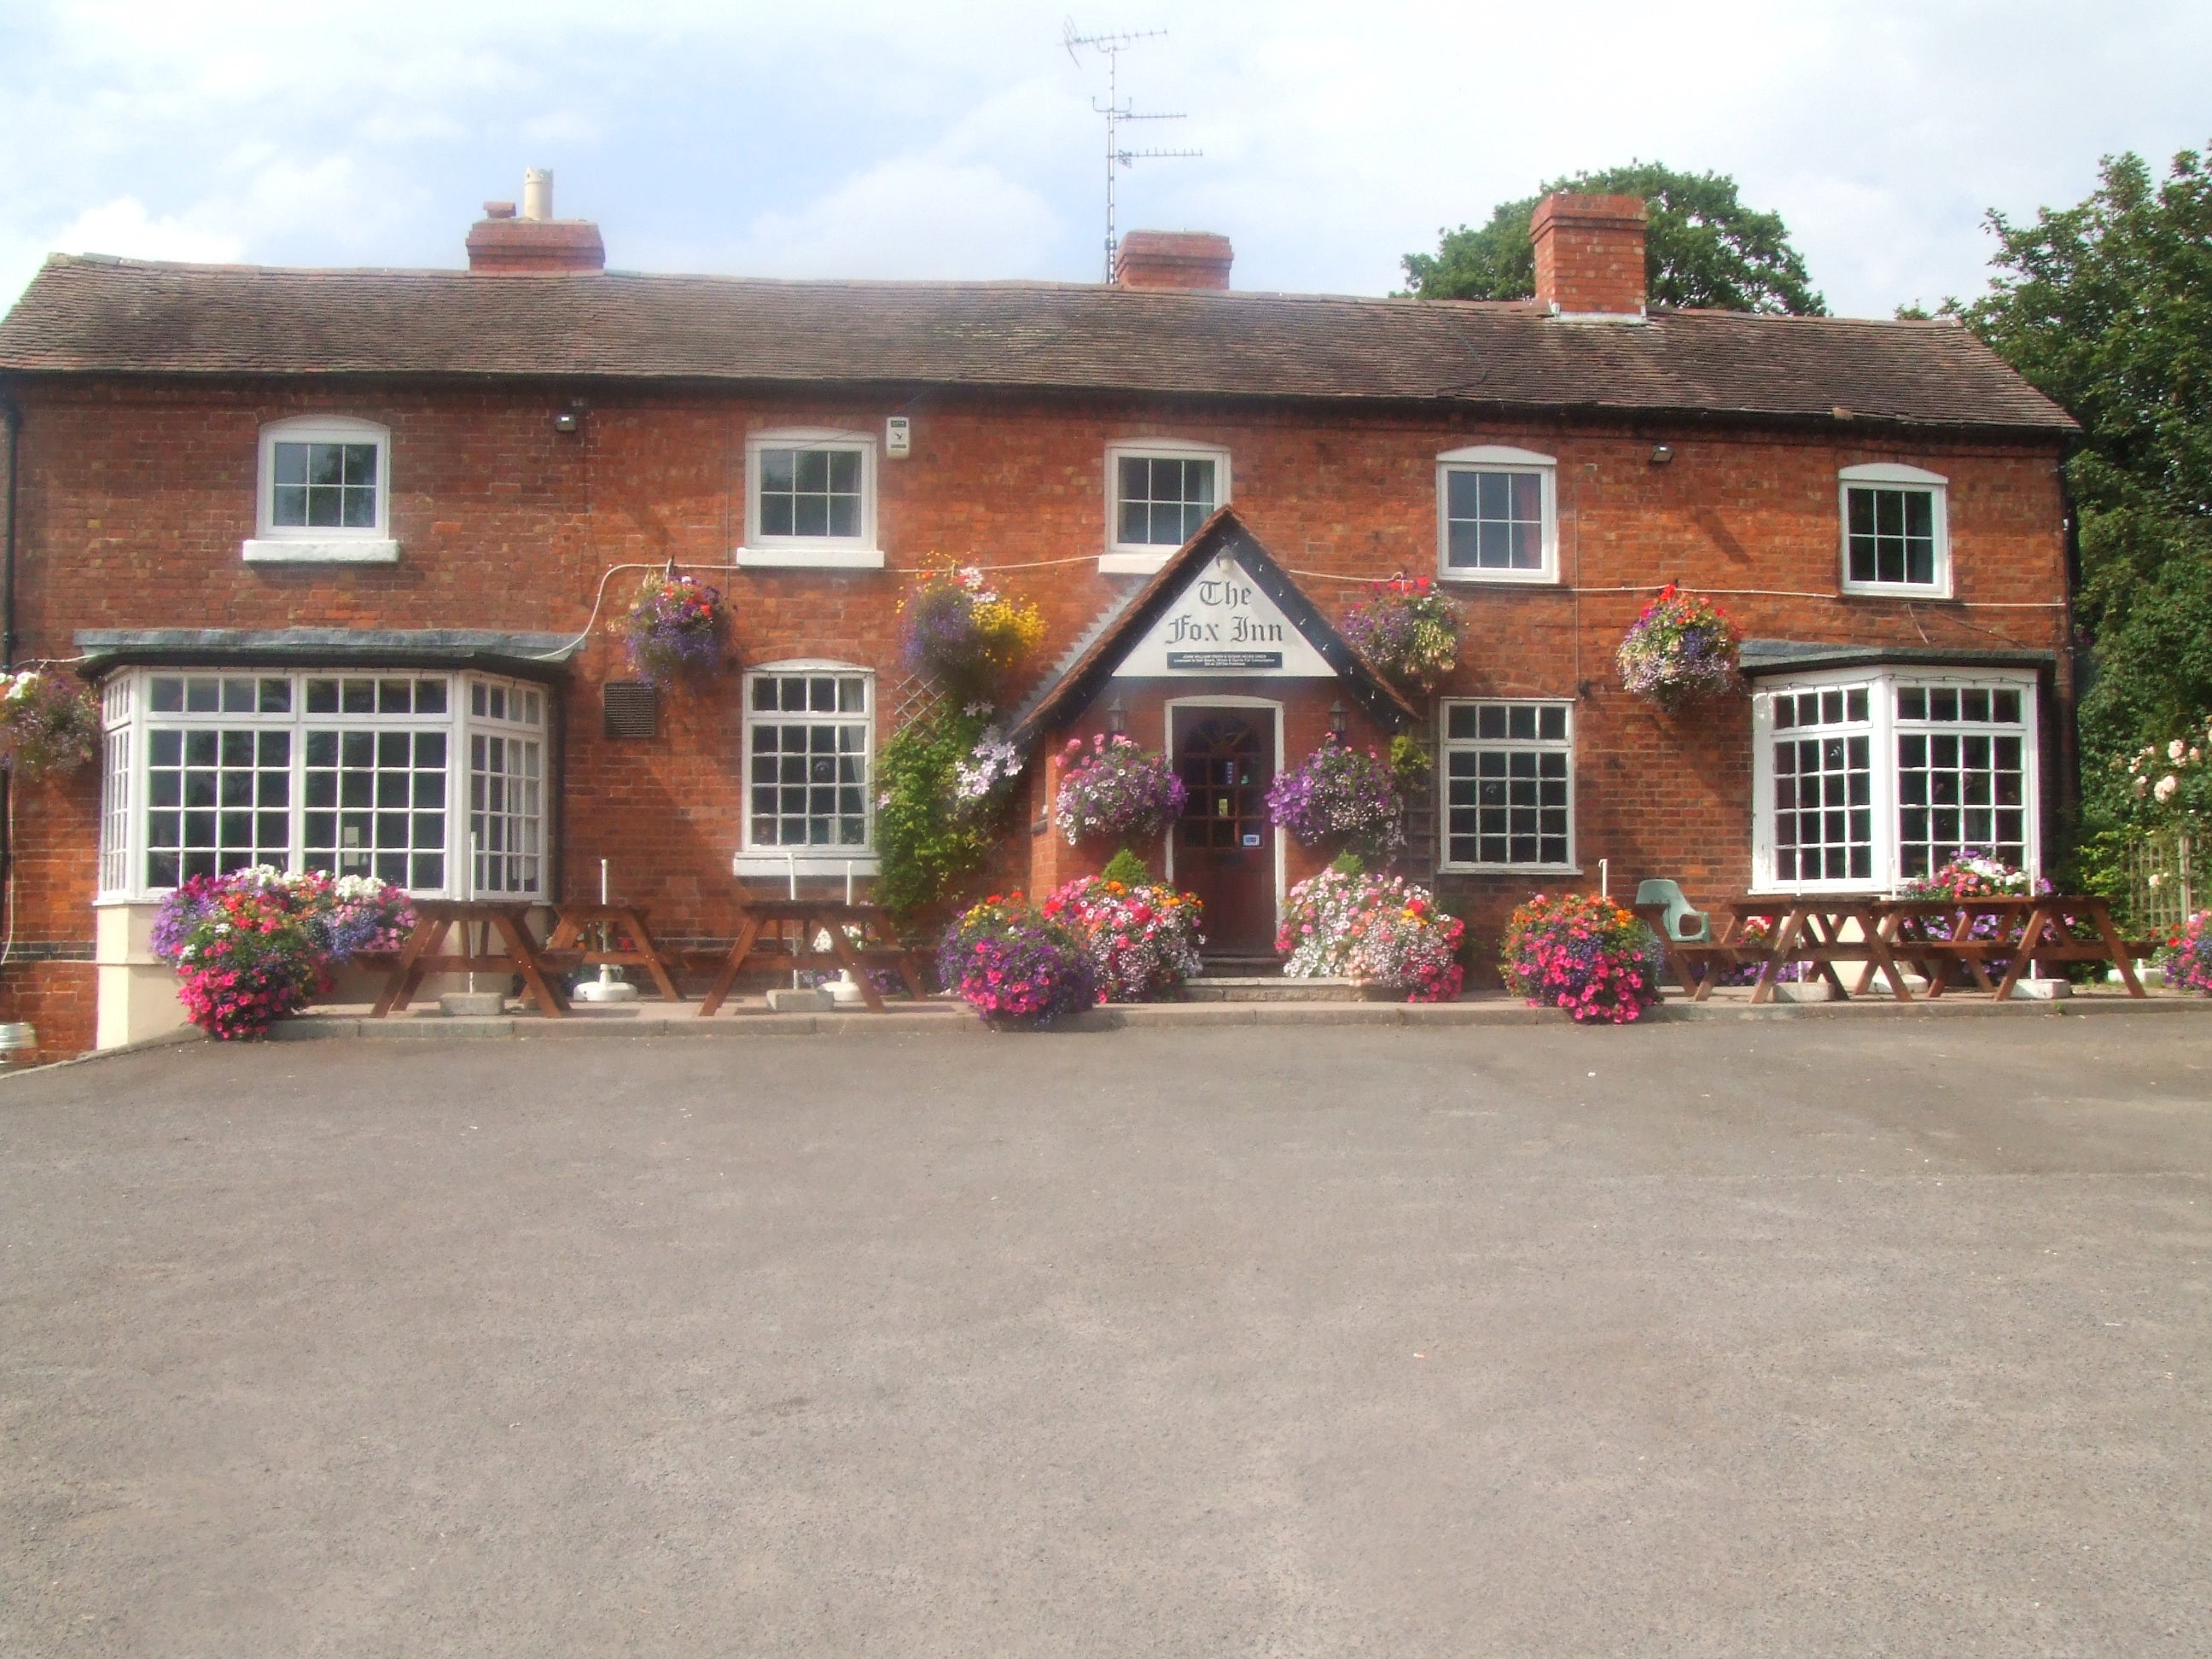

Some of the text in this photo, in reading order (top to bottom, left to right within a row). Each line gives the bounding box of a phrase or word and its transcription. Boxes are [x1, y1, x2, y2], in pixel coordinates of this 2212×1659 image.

[1198, 580, 1252, 609] The
[1165, 614, 1283, 644] Fox Inn
